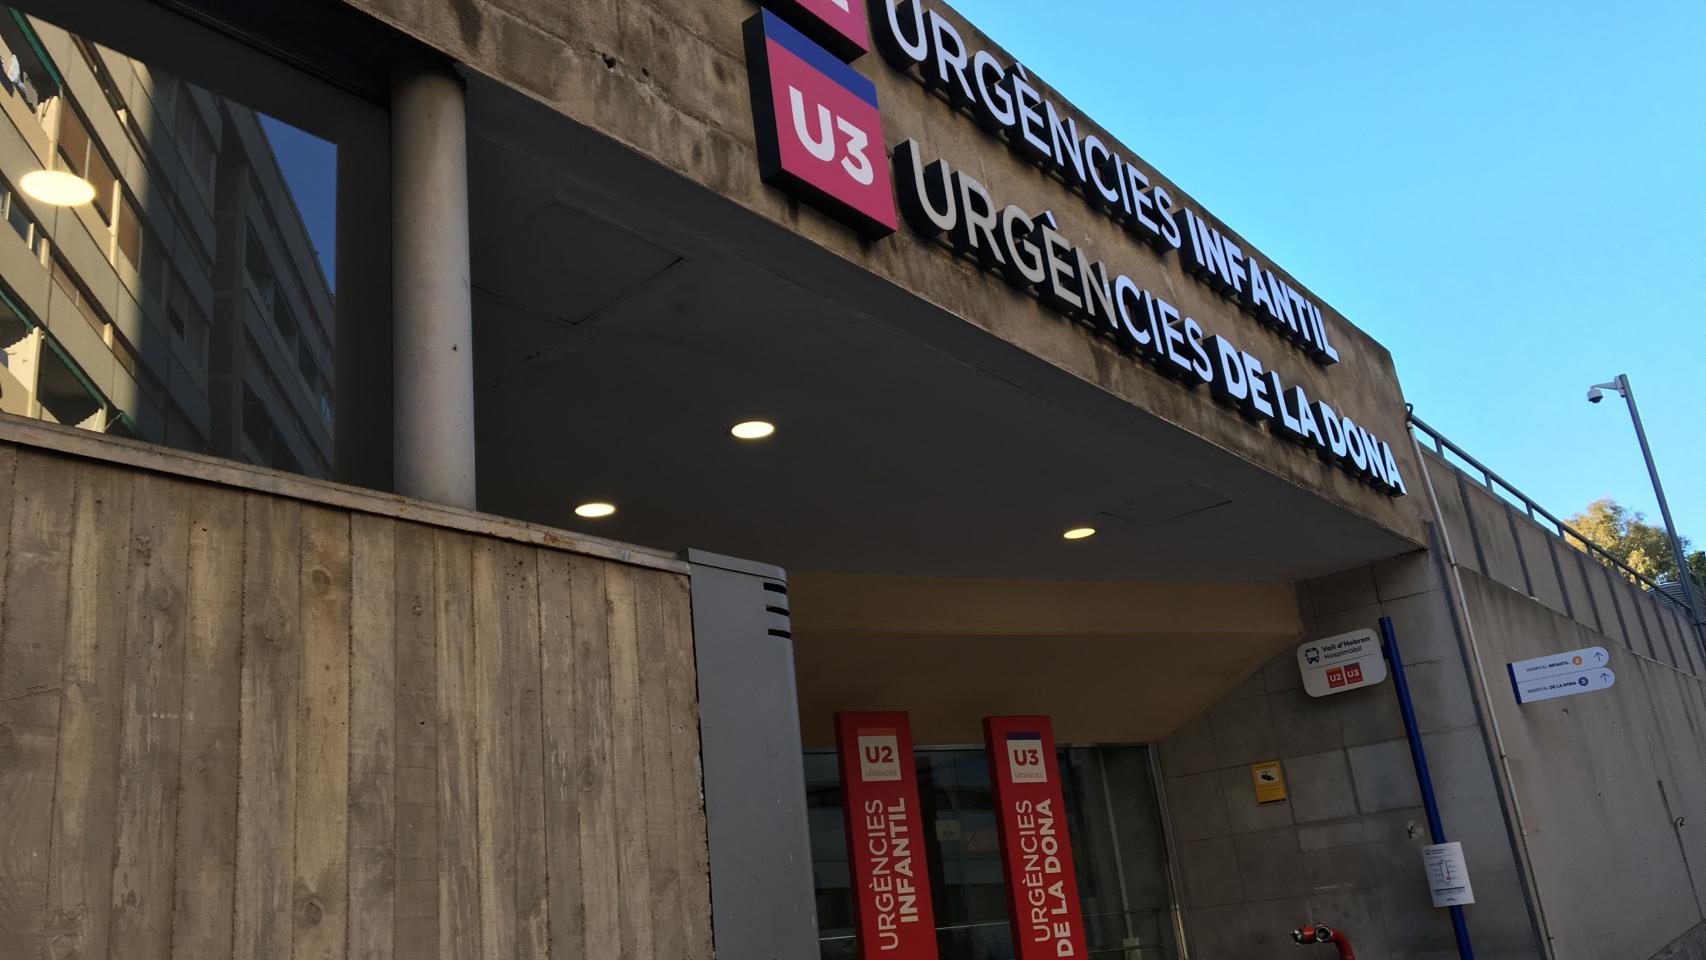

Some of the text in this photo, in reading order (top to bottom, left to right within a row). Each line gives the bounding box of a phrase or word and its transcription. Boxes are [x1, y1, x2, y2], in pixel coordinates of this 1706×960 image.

[788, 84, 874, 186] U3
[907, 138, 1407, 496] URGÈNCIES DE LA DONA
[1184, 206, 1339, 364] INFANTIL
[1322, 644, 1336, 652] Vall
[1329, 669, 1360, 682] U2 U3
[1527, 686, 1549, 694] HOSPITAL
[865, 745, 894, 764] U2
[1013, 749, 1040, 766] U3
[864, 799, 899, 951] URGÈNCIES
[887, 797, 919, 923] INFANTIL
[1016, 799, 1051, 943] URGÈNCIES
[1034, 798, 1075, 958] DE LA DONA
